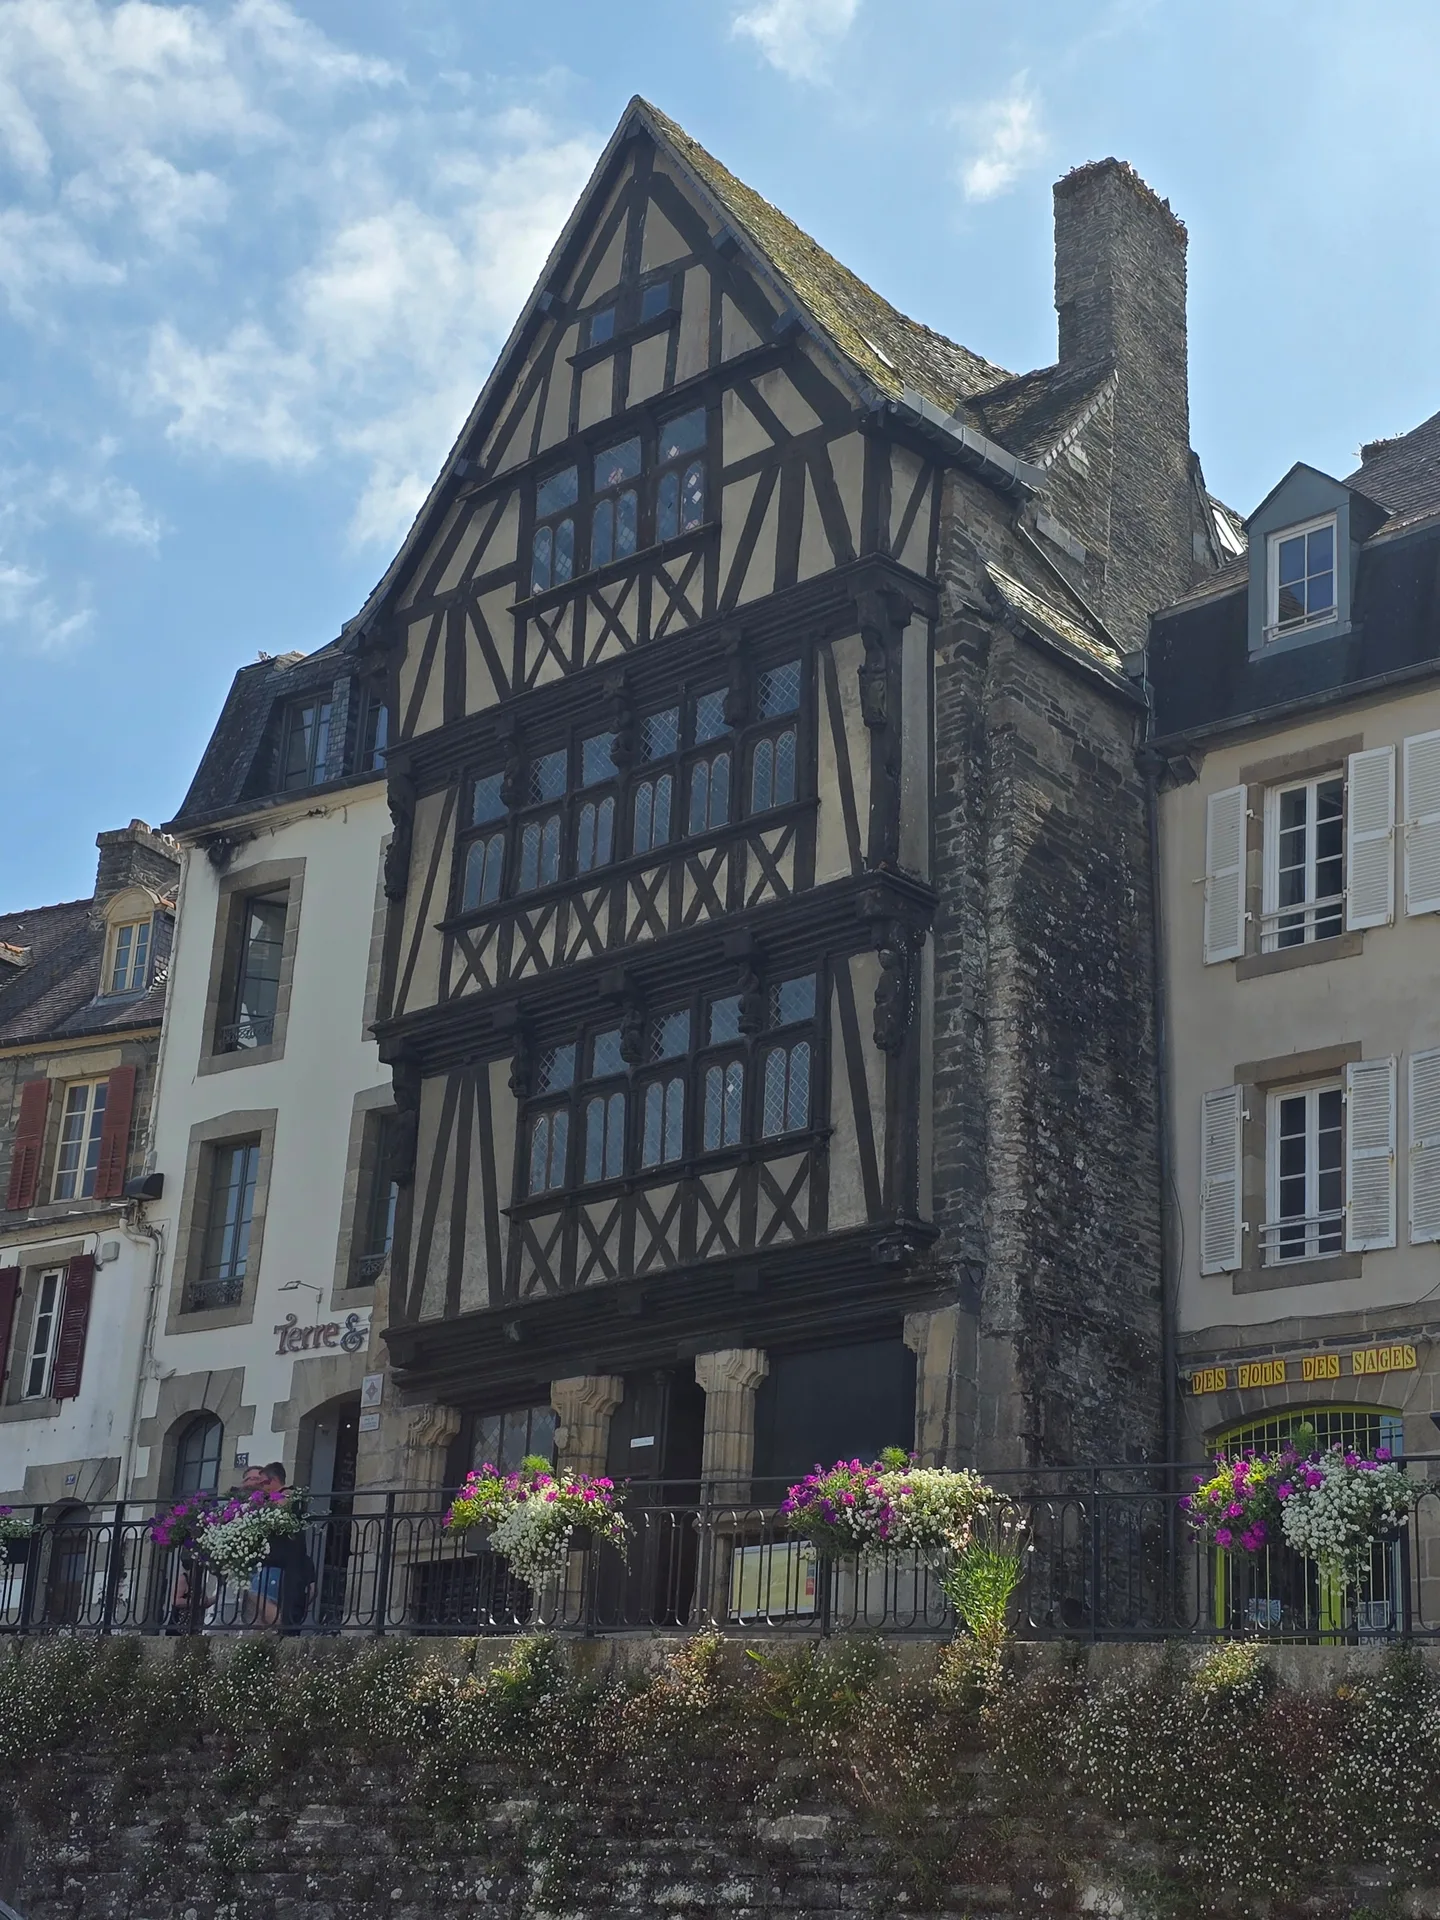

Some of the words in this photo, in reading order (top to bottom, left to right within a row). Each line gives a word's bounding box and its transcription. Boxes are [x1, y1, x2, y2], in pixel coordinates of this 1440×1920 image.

[273, 1313, 340, 1355] Terre
[340, 1313, 368, 1352] &
[1193, 1370, 1225, 1392] DES
[1239, 1362, 1284, 1387] FOUS
[1303, 1356, 1338, 1379] DES
[1353, 1346, 1415, 1373] SAGES
